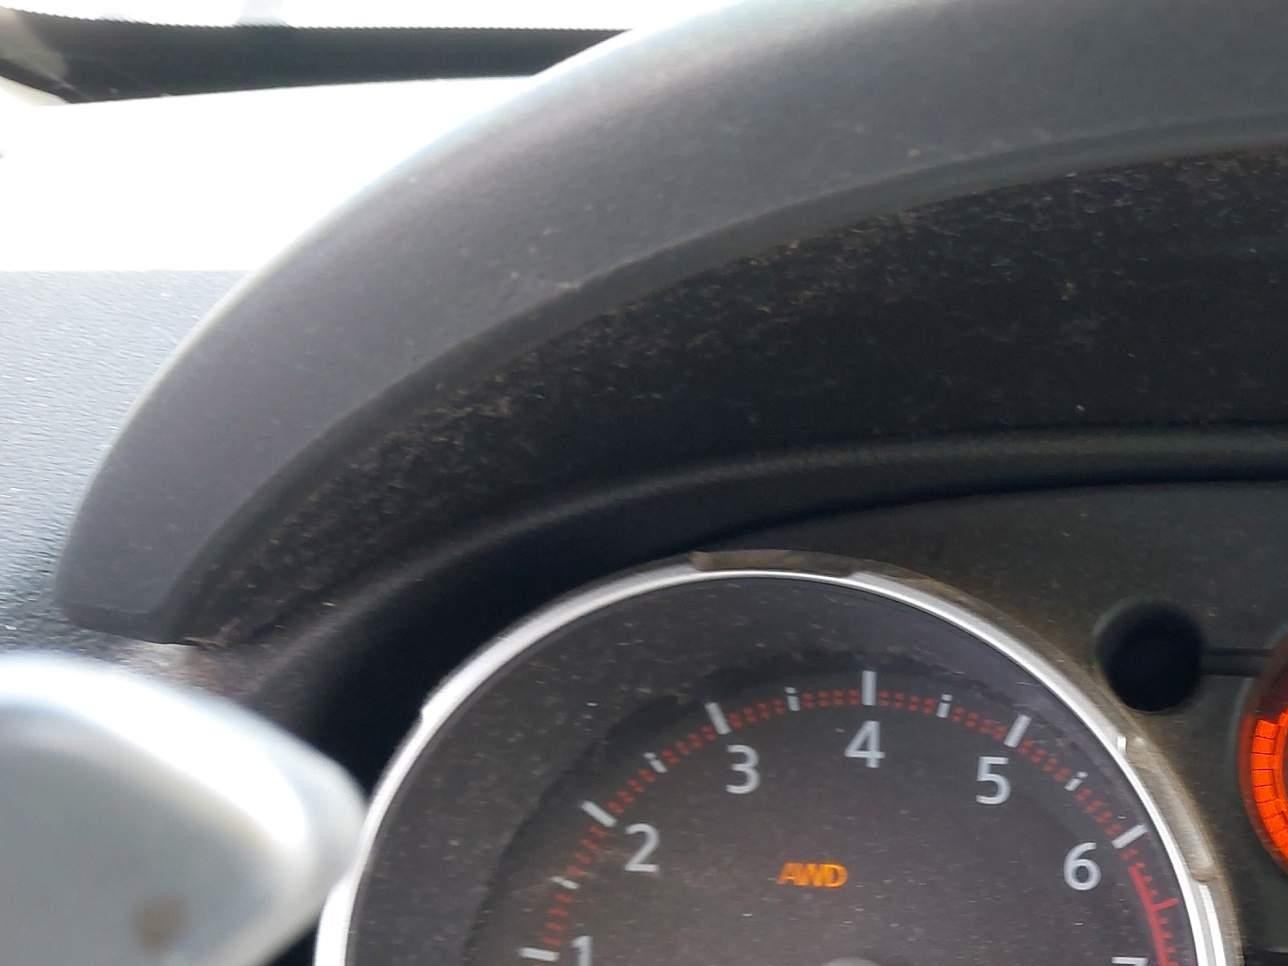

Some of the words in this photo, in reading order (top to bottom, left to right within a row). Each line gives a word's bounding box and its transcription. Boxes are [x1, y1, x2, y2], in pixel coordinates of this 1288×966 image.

[844, 720, 886, 769] 4
[725, 744, 761, 795] 3
[975, 756, 1012, 805] 5
[624, 823, 660, 873] 2
[1063, 841, 1101, 891] 6
[776, 861, 848, 888] AWD
